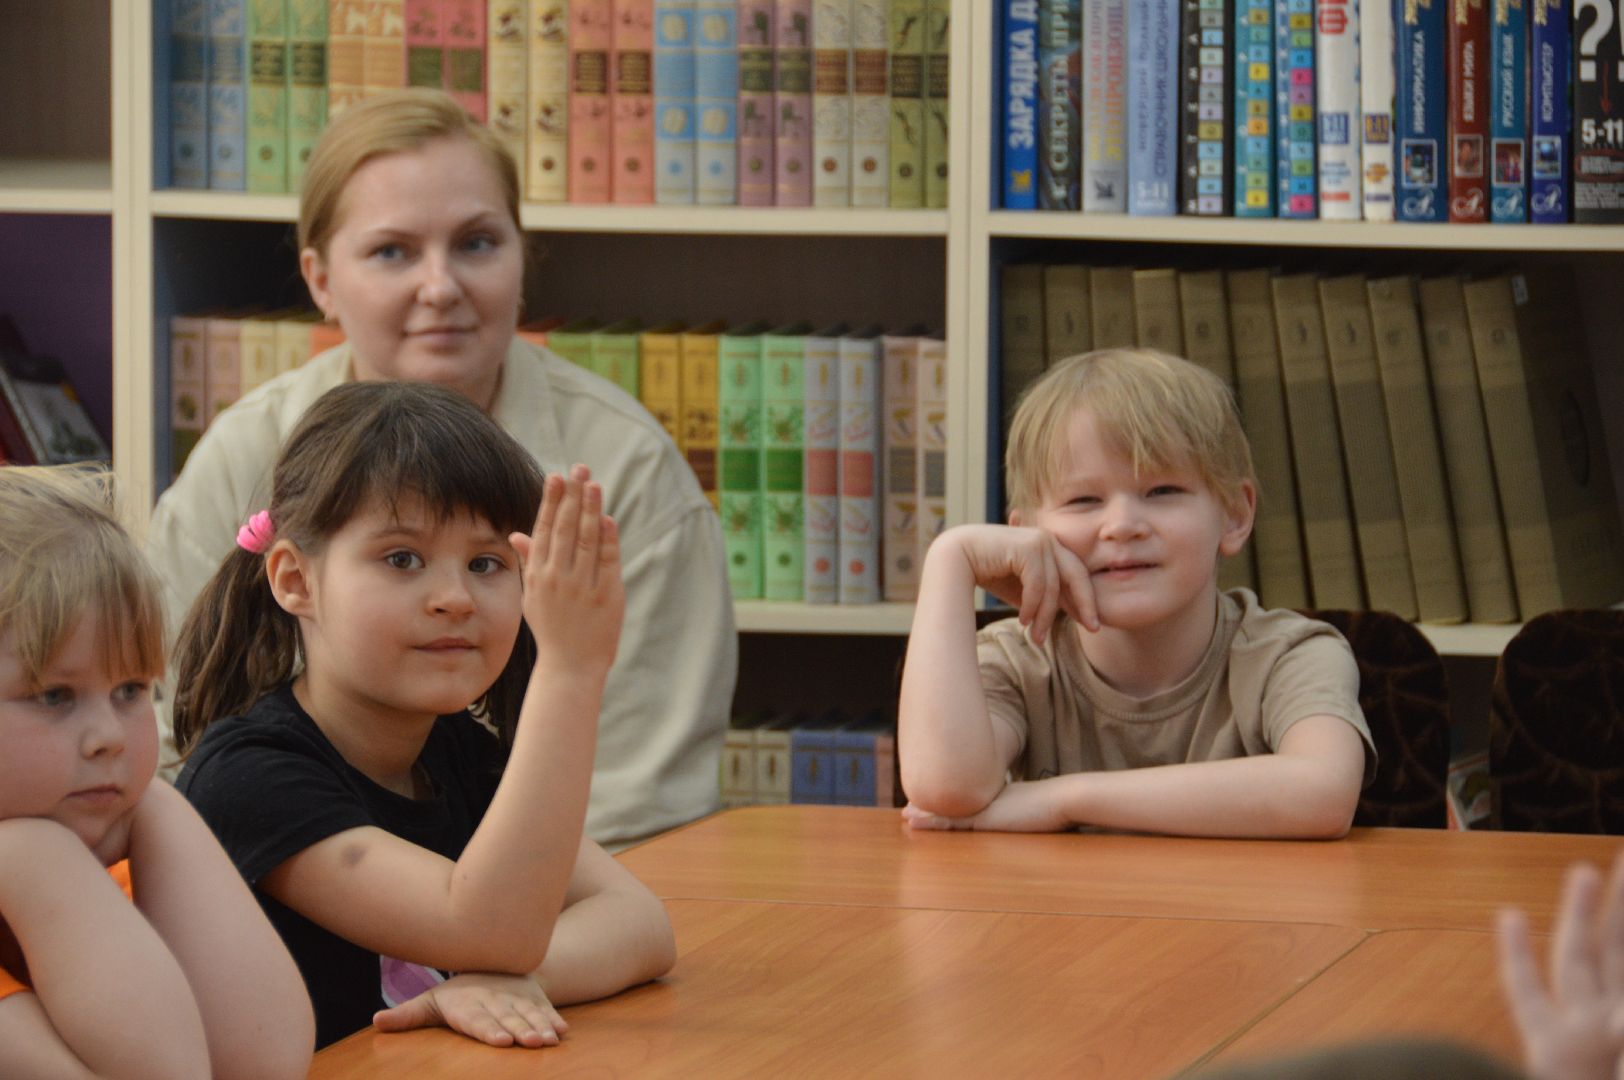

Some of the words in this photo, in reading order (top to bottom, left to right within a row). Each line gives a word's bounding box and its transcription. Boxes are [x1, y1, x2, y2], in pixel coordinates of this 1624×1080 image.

[1009, 29, 1037, 149] ЗАРЯДКА
[1412, 30, 1426, 133] ИНФОРМАТИКА
[1462, 40, 1475, 78] МИРА
[1501, 33, 1515, 67] ЯЗЫК
[1541, 42, 1554, 123] КОМПЬЮТЕР
[1050, 55, 1069, 171] СЕКРЕТЫ
[1153, 78, 1168, 177] СПРАВОЧНИК
[1462, 79, 1475, 122] ЯЗЫКИ
[1501, 69, 1515, 127] РУССКИЙ
